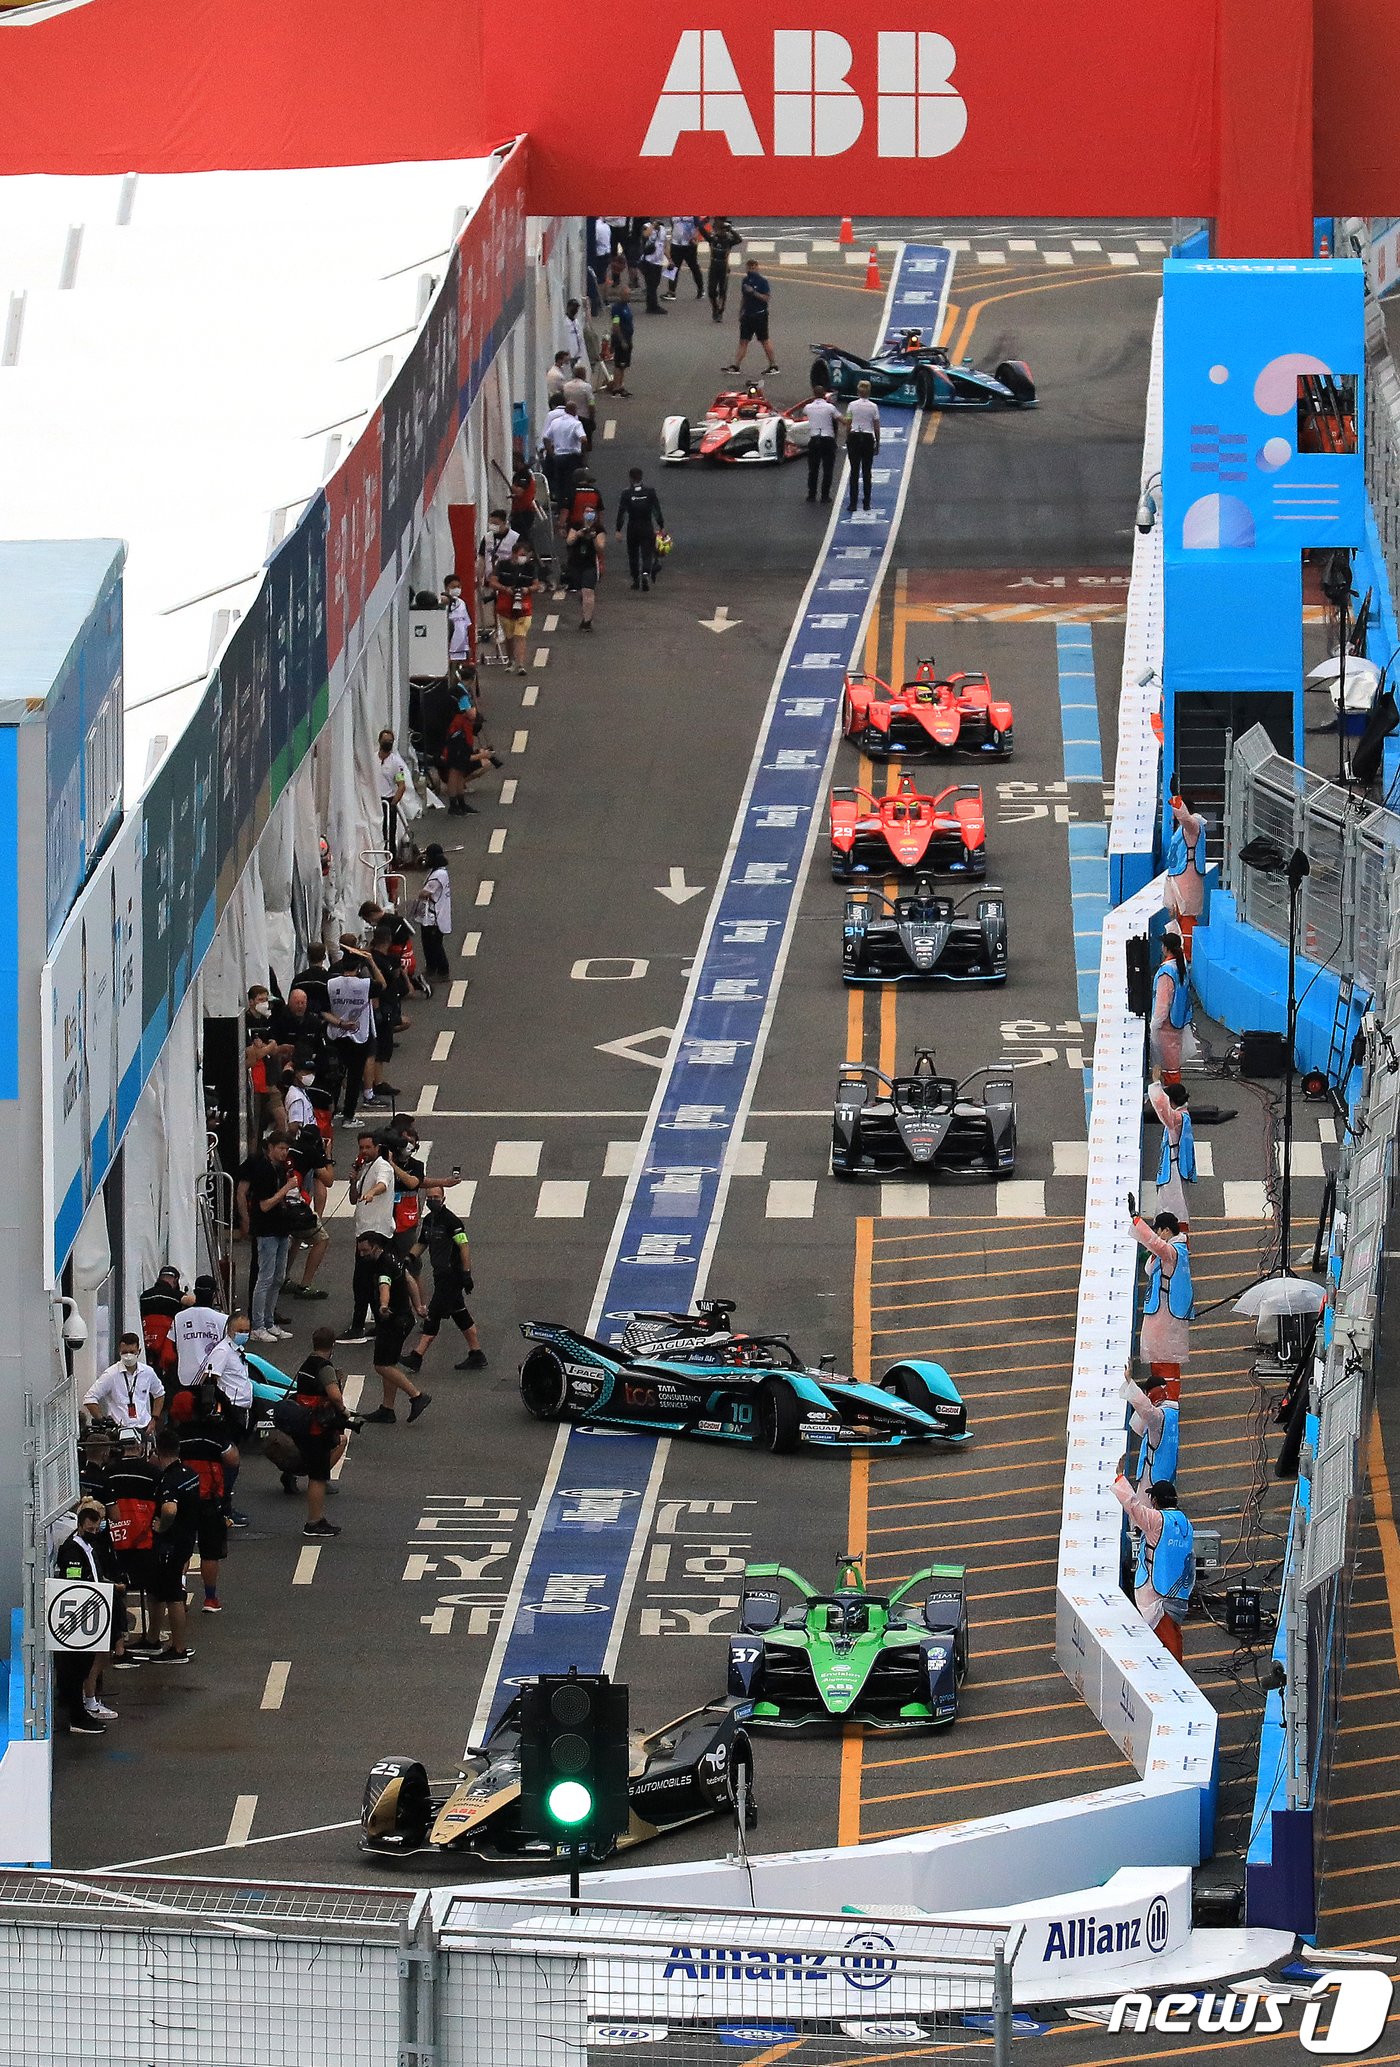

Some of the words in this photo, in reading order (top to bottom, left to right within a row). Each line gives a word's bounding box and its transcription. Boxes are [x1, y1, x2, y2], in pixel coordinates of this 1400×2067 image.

[639, 29, 968, 158] ABB
[834, 827, 853, 837] 29
[844, 926, 865, 937] 94
[839, 1110, 854, 1122] 11
[700, 1301, 714, 1312] NAT
[650, 1337, 707, 1352] JAGUAR
[568, 1365, 605, 1379] I-PACE
[657, 1384, 677, 1393] TATA
[658, 1393, 702, 1403] CONSULTANCY
[659, 1400, 689, 1409] SERVICES
[731, 1402, 753, 1424] 10
[800, 1424, 840, 1432] JAGUAR
[542, 1573, 607, 1602] Allianz
[58, 1599, 101, 1636] 50
[732, 1647, 761, 1664] 37
[825, 1683, 854, 1691] ABB
[370, 1762, 401, 1777] 25
[634, 1774, 692, 1795] AUTOMOBILES
[1042, 1917, 1142, 1962] Allianz
